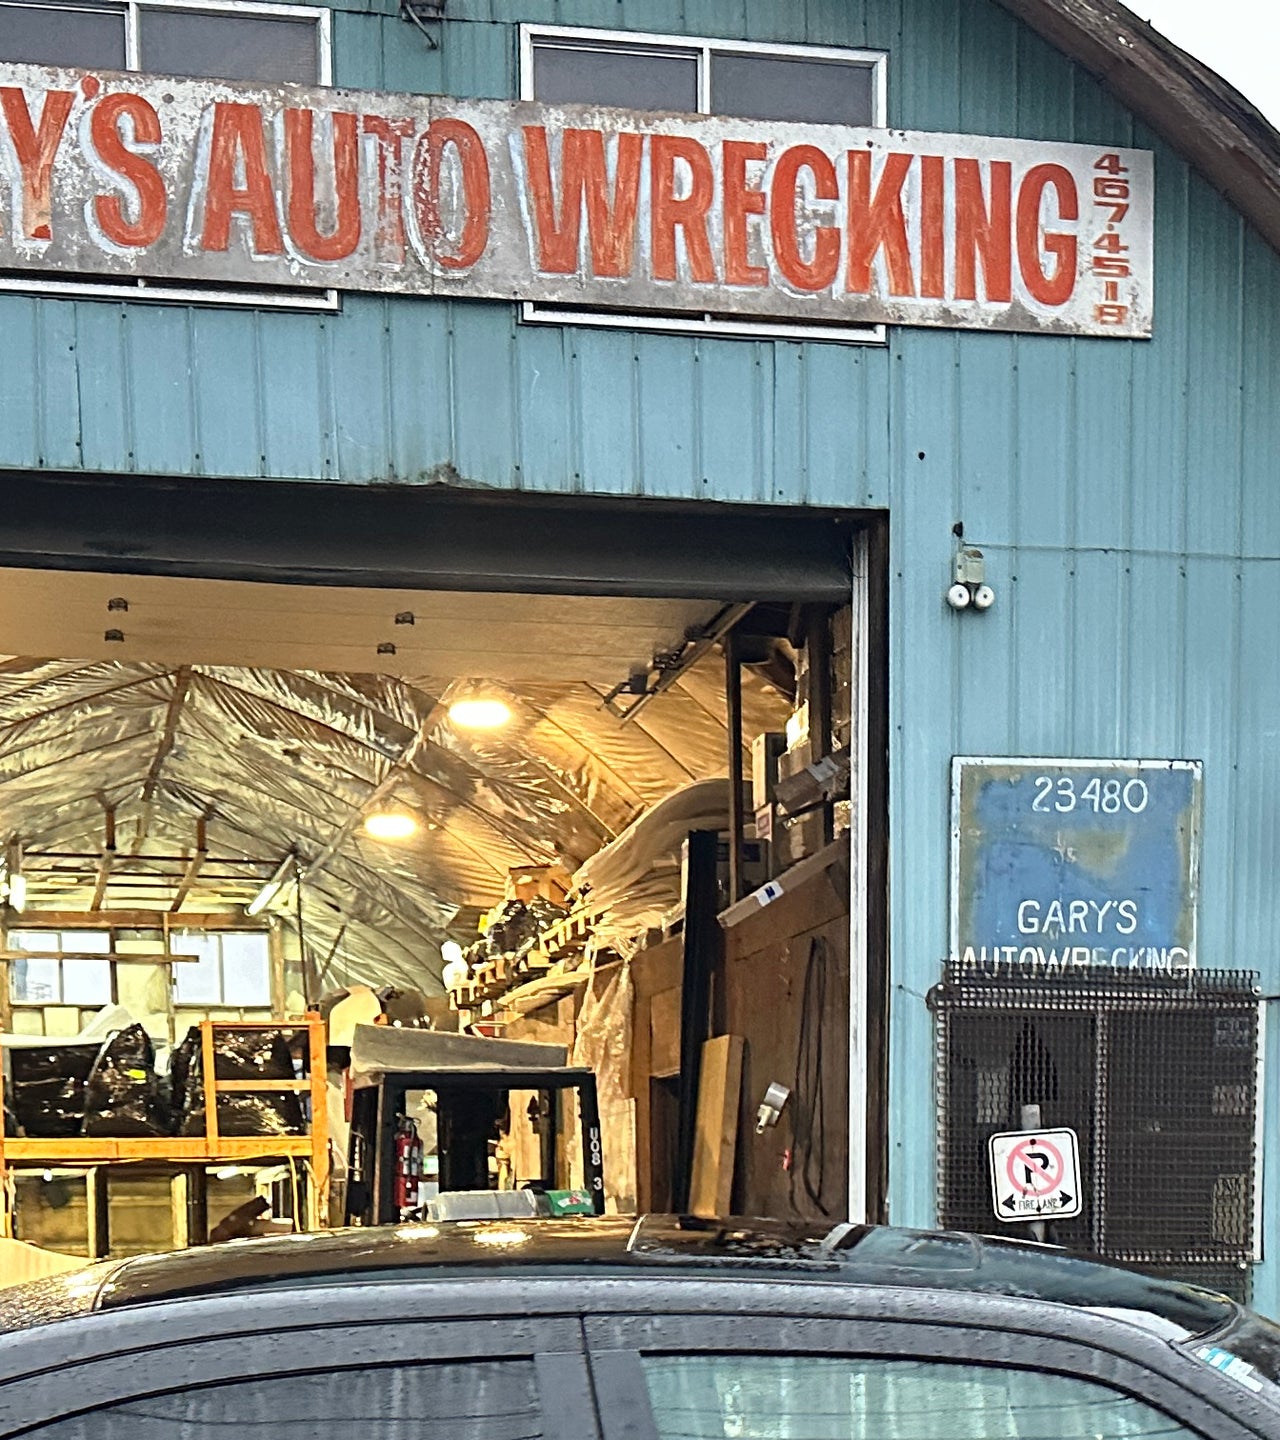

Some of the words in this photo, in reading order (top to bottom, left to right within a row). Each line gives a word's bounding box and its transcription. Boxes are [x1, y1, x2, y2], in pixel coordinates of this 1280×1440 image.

[202, 102, 490, 269] AUTO
[521, 126, 1079, 306] WRECKING
[1032, 776, 1148, 814] 23480
[1017, 899, 1138, 935] GARY'S
